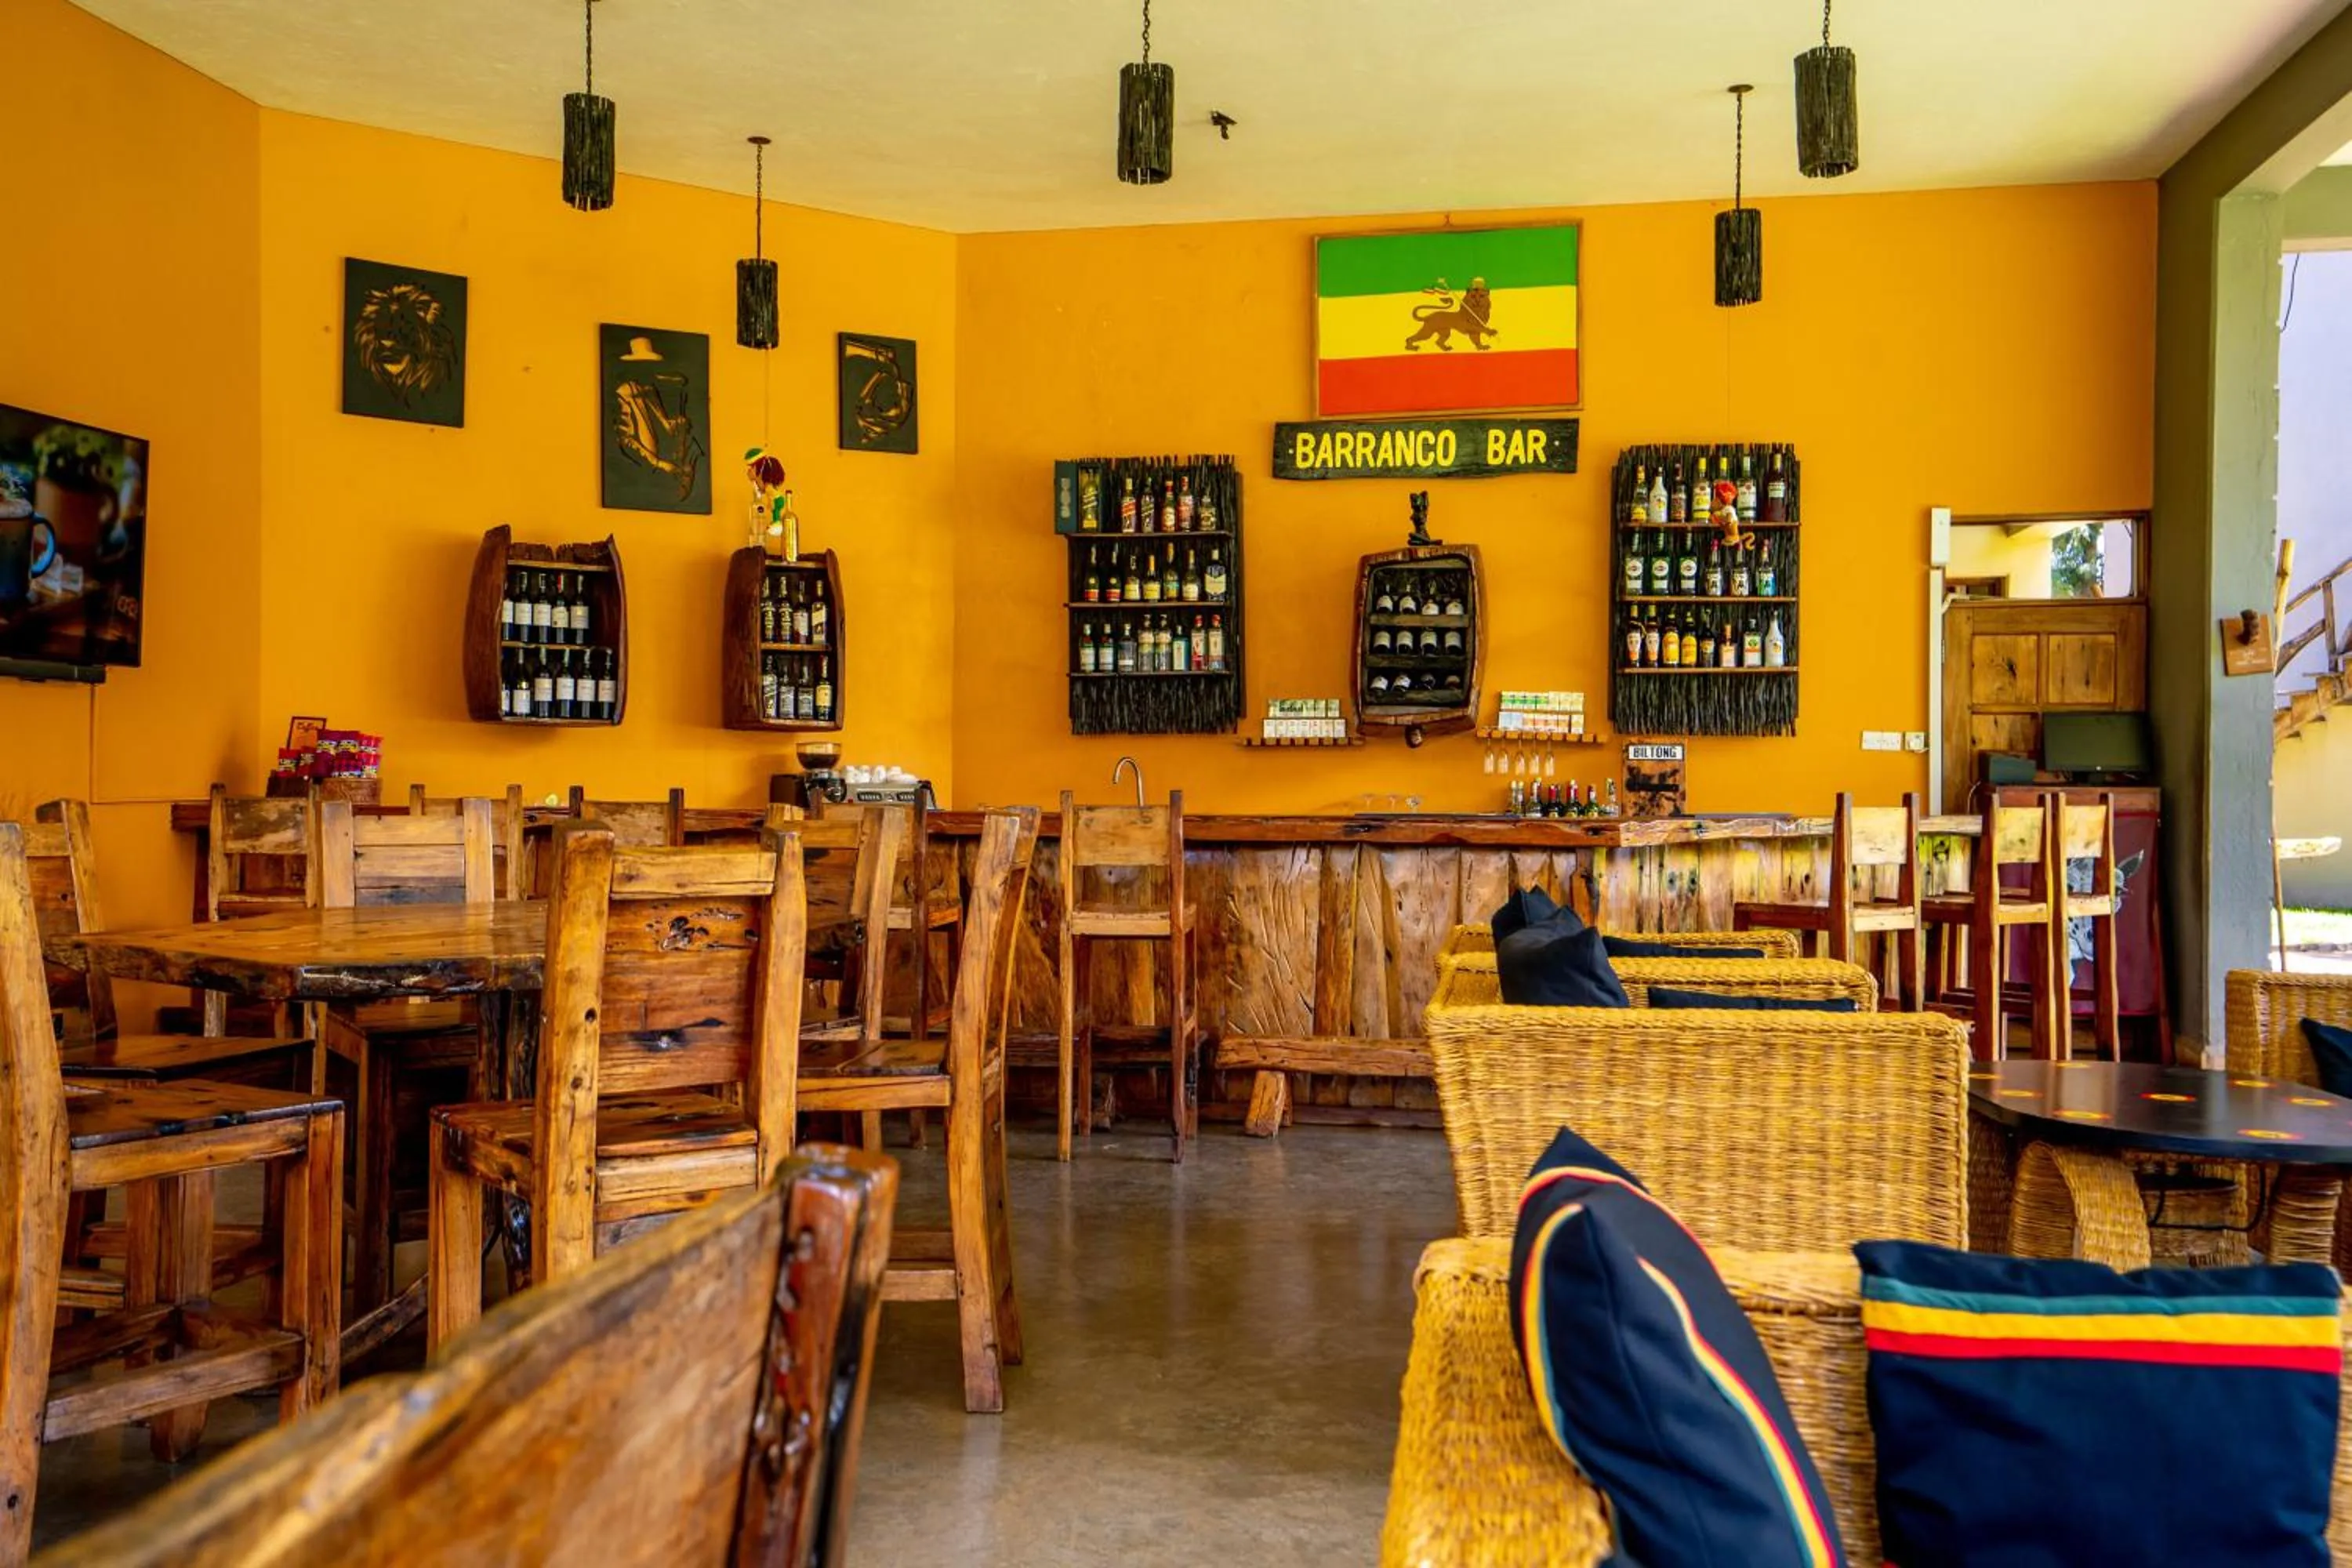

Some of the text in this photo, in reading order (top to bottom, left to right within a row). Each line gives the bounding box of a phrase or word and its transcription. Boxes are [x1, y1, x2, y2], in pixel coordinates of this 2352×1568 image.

[1296, 429, 1547, 468] BARRANCO BAR
[1633, 746, 1677, 758] BILTONG
